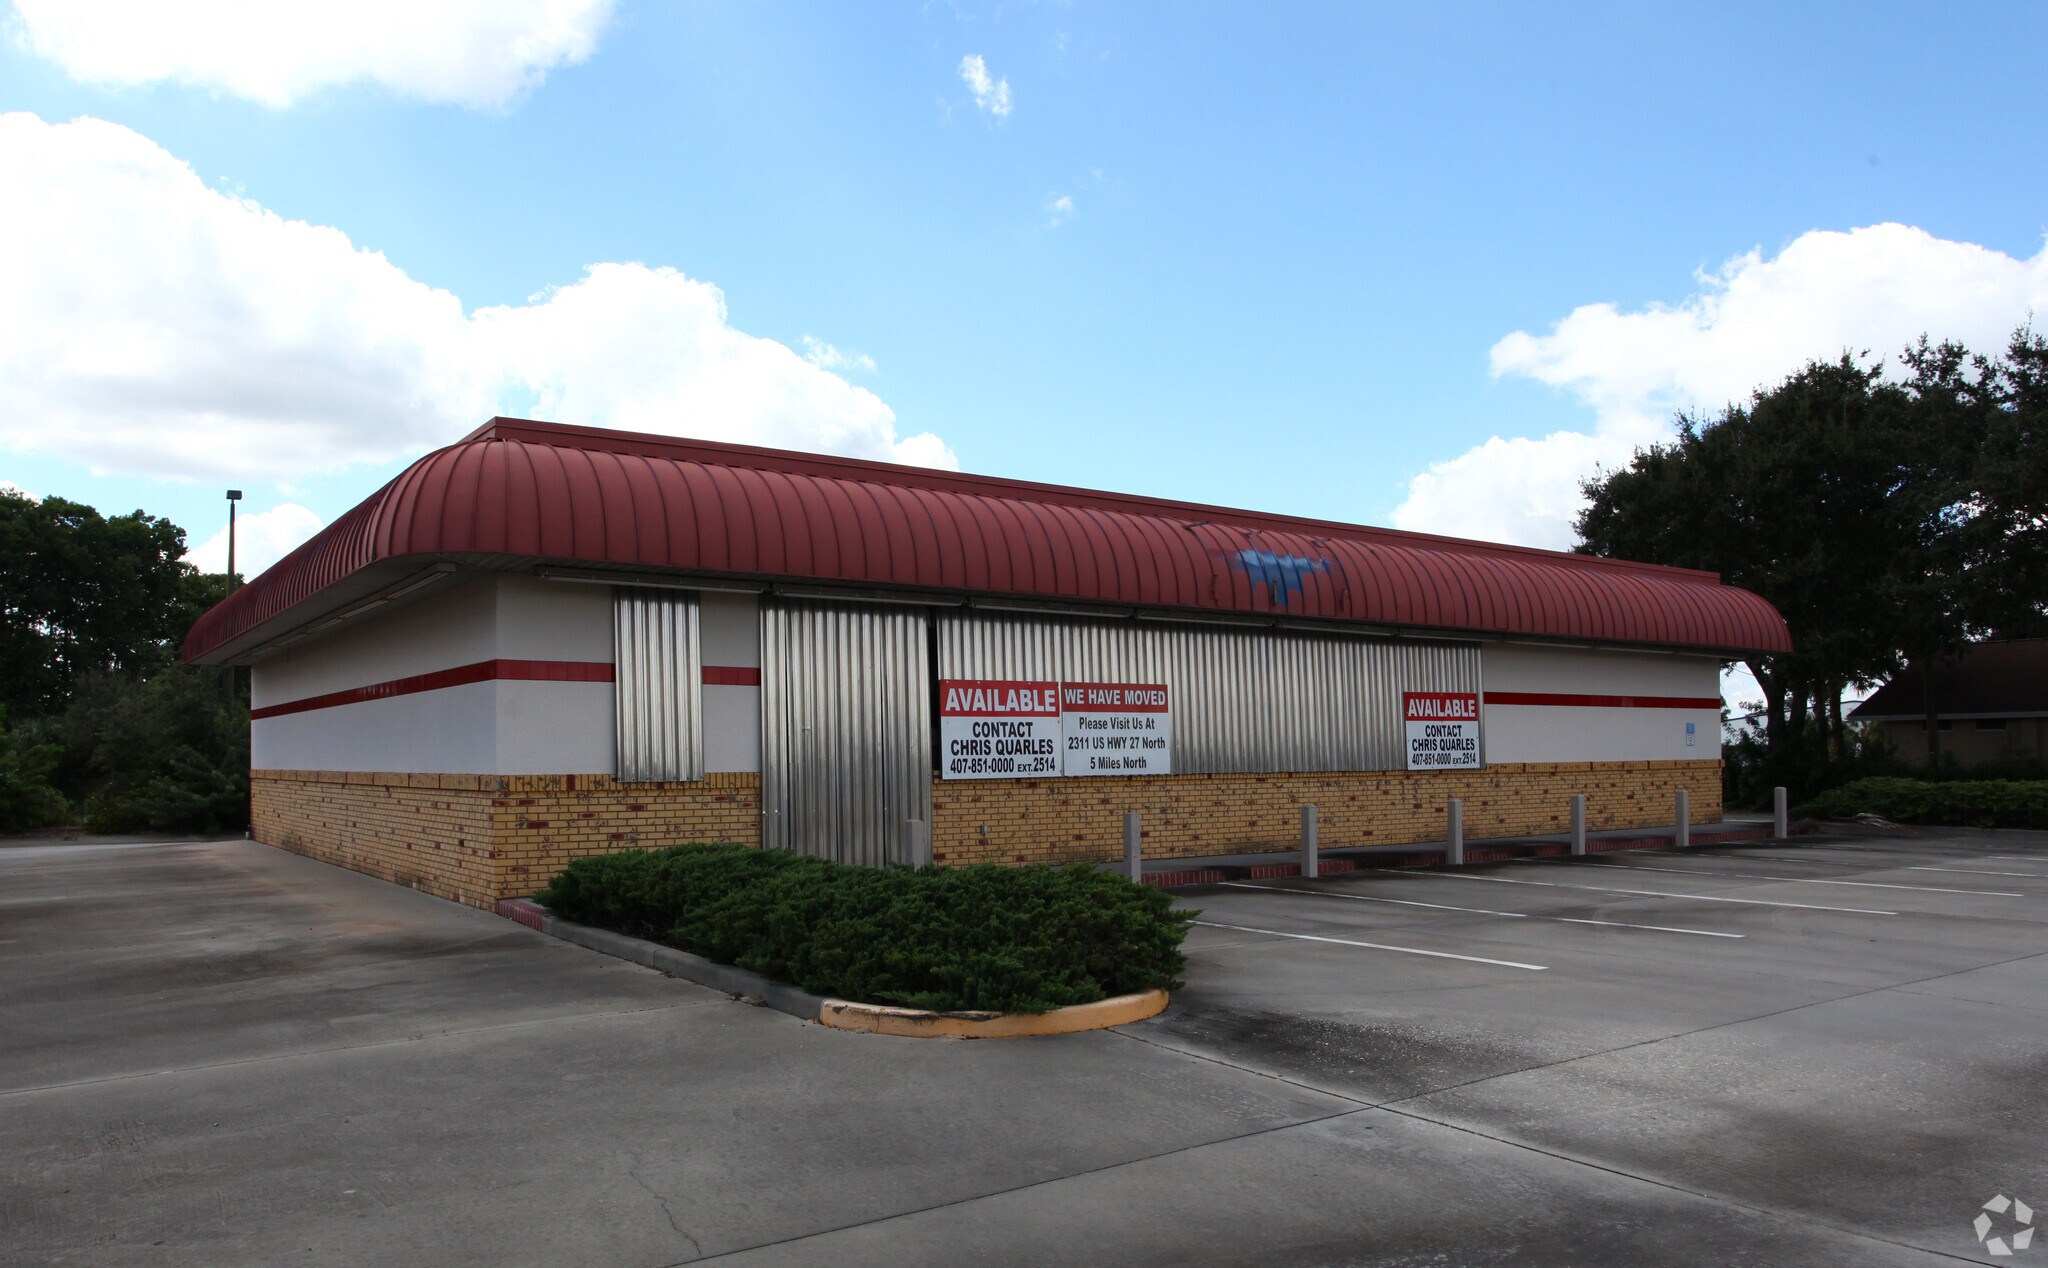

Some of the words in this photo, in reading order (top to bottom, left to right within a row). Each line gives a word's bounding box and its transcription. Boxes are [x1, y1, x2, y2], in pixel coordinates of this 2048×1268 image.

[945, 688, 1056, 712] AVAILABLE
[1064, 688, 1085, 704] WE
[1088, 689, 1121, 705] HAVE
[1124, 690, 1166, 706] MOVED
[1408, 698, 1476, 717] AVAILABLE
[972, 721, 1033, 738] CONTACT
[1079, 717, 1108, 730] Please
[1110, 717, 1130, 730] Visit
[1132, 717, 1143, 730] Us
[1145, 717, 1155, 730] At
[1425, 724, 1462, 737] CONTACT
[951, 739, 992, 756] CHRIS
[996, 739, 1054, 756] QUARLES
[1068, 737, 1089, 750] 2311
[1092, 737, 1105, 750] US
[1107, 737, 1127, 750] HWY
[1130, 737, 1140, 749] 27
[1142, 737, 1166, 749] North
[1412, 738, 1438, 752] CHRIS
[1439, 738, 1475, 752] QUARLES
[950, 758, 1014, 773] 407-851-0000
[1090, 757, 1096, 770] 5
[1098, 757, 1120, 769] Miles
[1123, 756, 1147, 769] North
[1412, 753, 1451, 765] 407-851-0000
